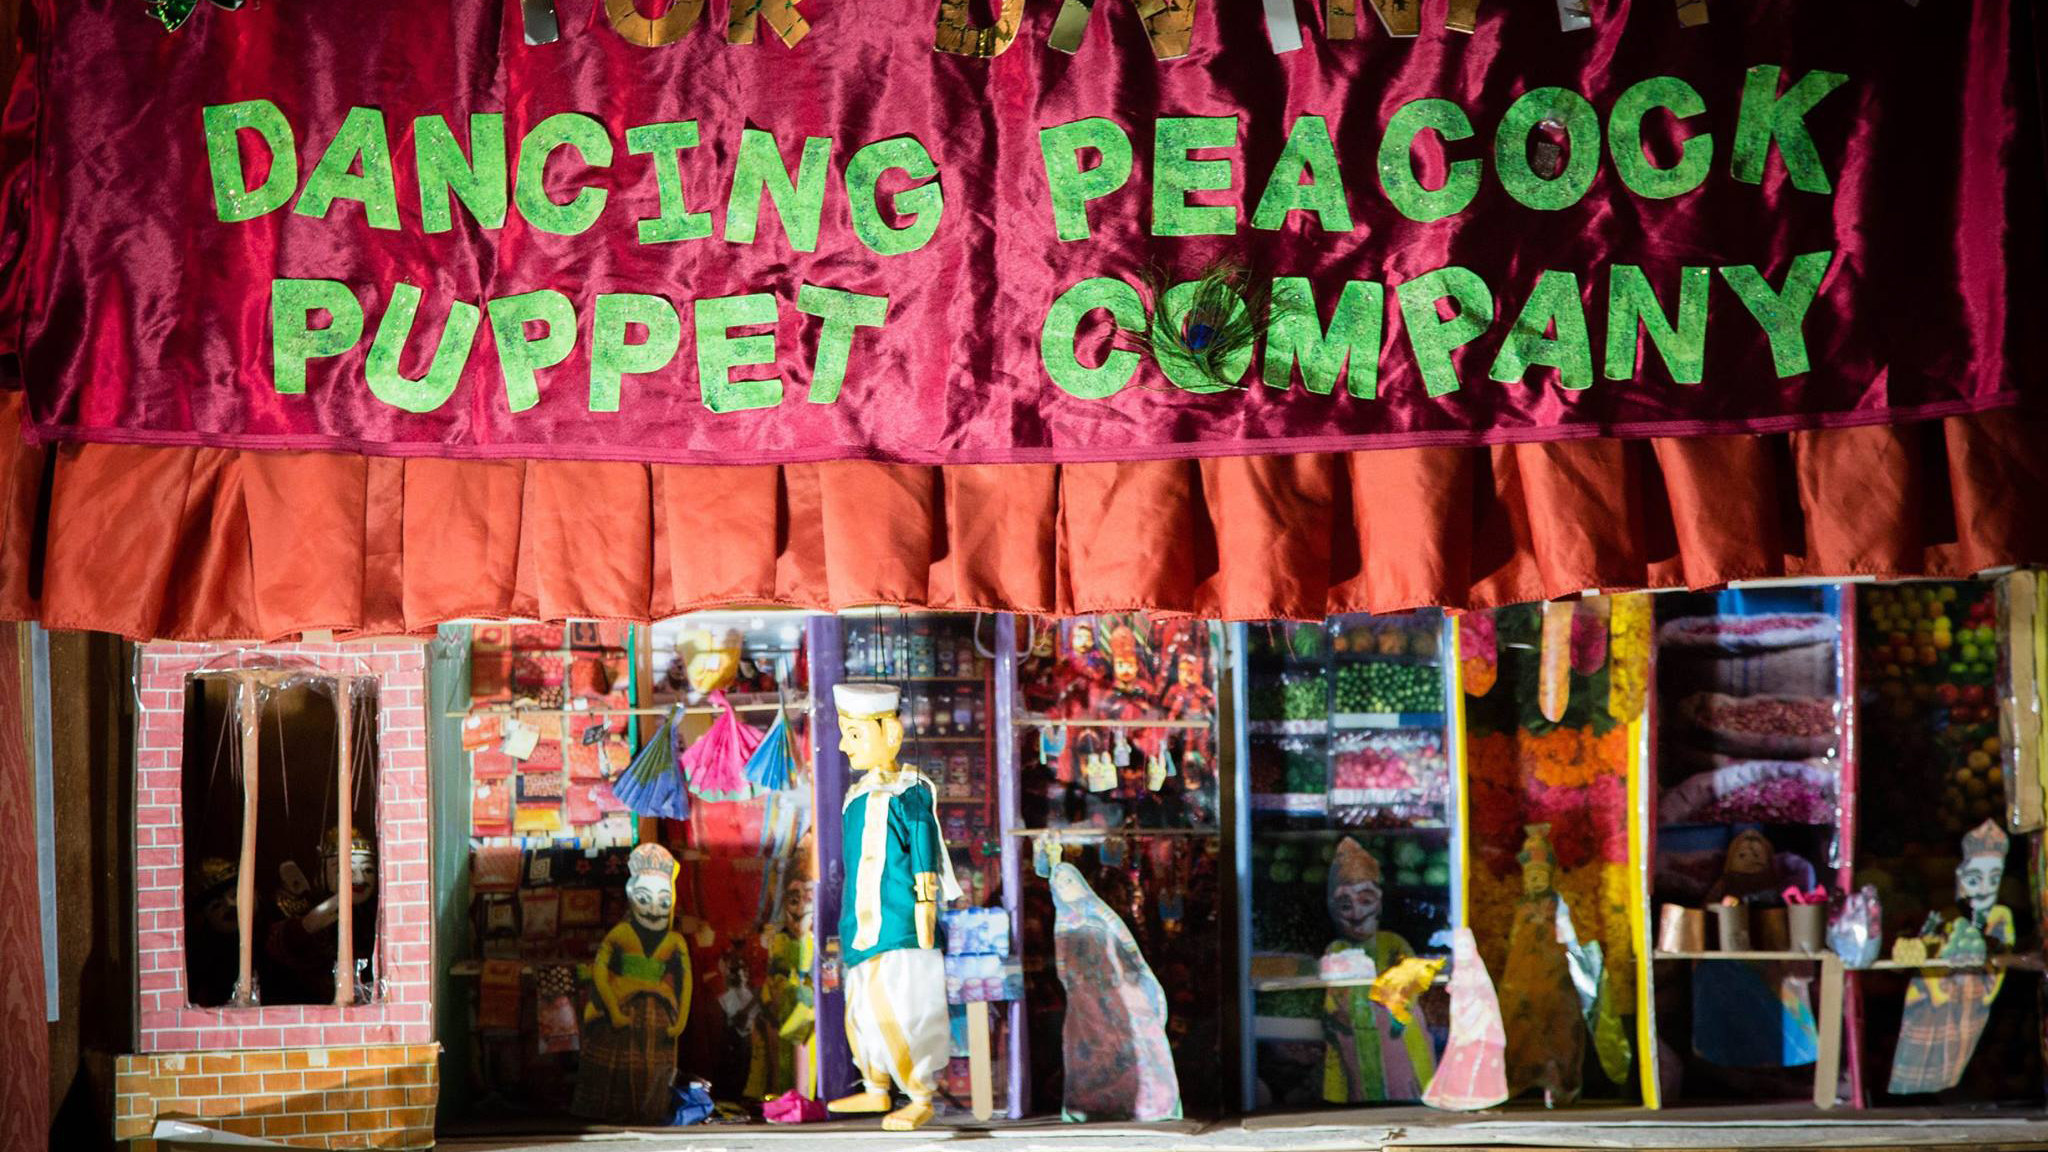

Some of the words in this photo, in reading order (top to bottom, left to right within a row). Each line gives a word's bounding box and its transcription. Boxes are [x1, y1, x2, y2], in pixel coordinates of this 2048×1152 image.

[202, 97, 945, 257] DANCING
[1039, 64, 1849, 242] PEACOCK
[271, 277, 889, 414] PUPPET
[1041, 250, 1833, 400] COMPANY
